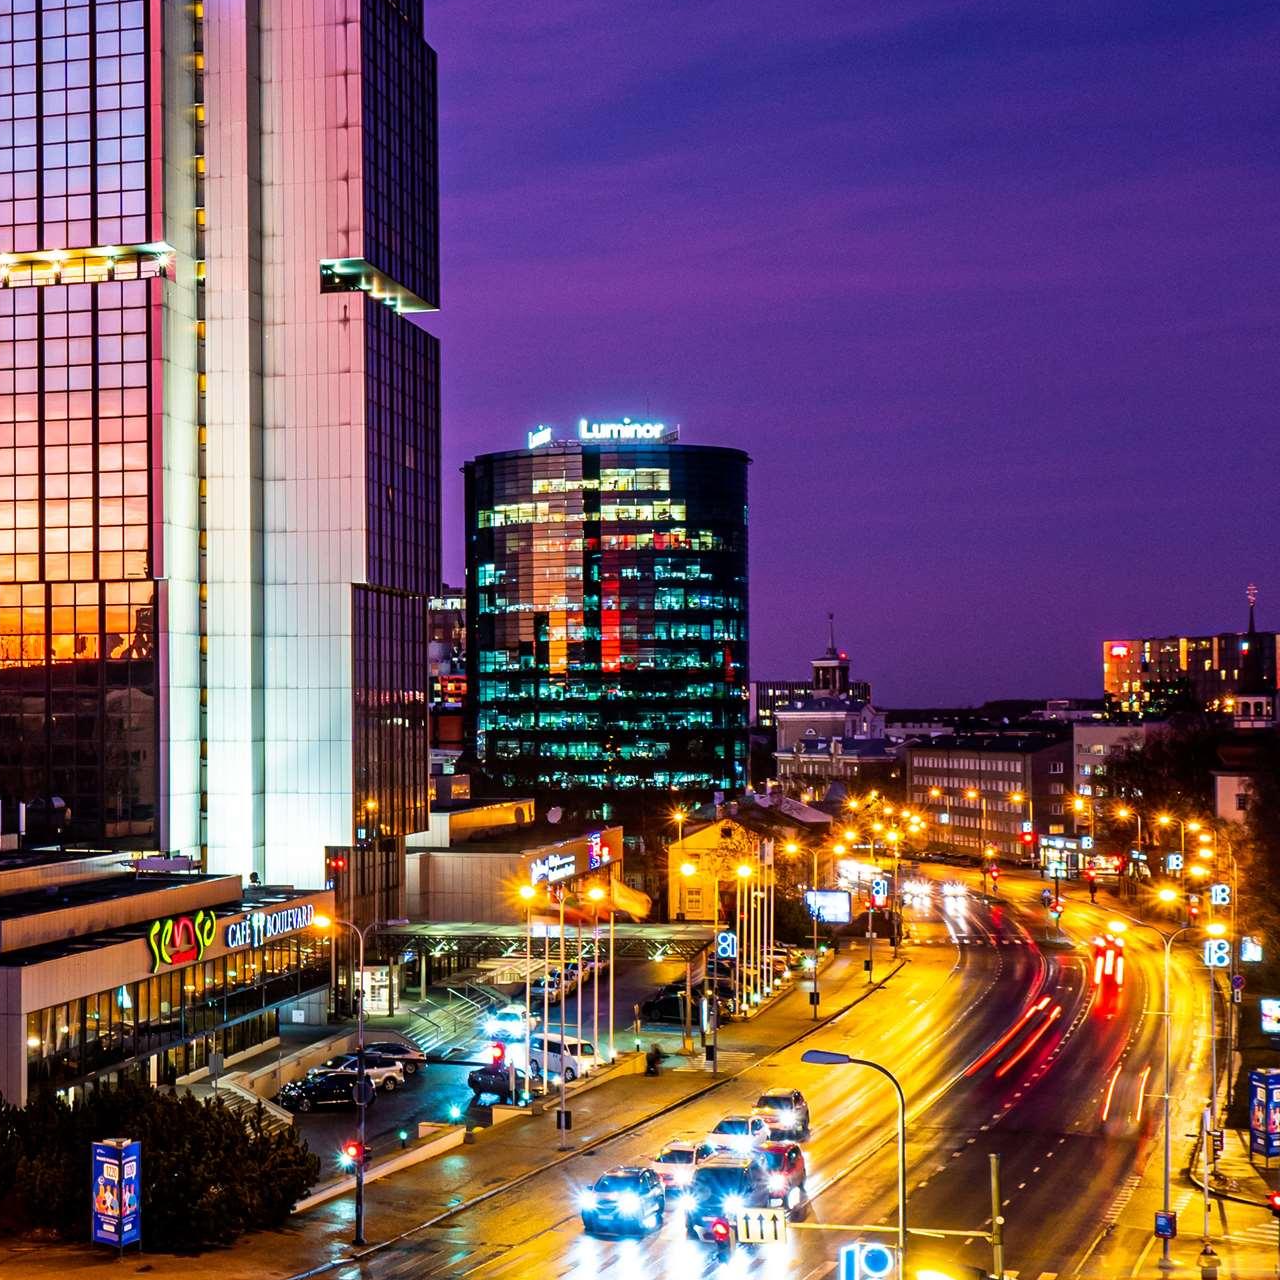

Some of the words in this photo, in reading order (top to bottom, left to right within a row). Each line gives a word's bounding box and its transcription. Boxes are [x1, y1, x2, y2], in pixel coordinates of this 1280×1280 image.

[580, 417, 664, 439] Luminor
[226, 914, 251, 948] CAFÉ
[266, 904, 314, 937] BOULEVARD
